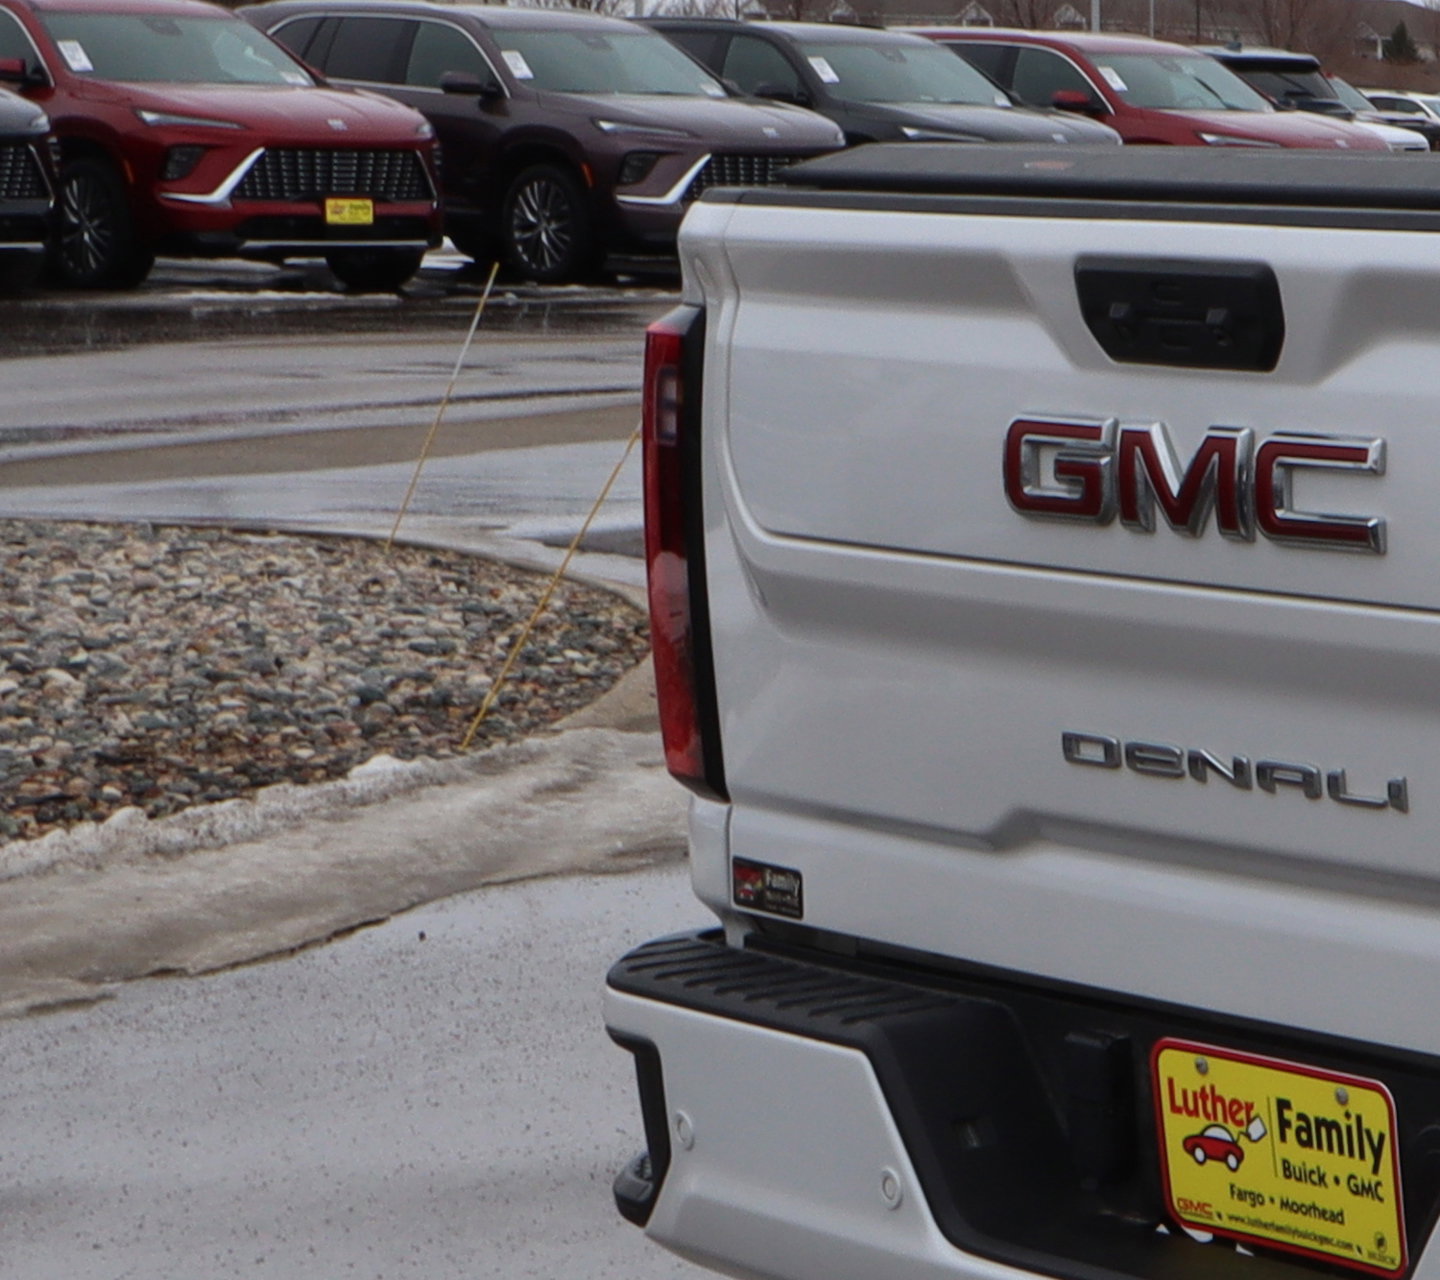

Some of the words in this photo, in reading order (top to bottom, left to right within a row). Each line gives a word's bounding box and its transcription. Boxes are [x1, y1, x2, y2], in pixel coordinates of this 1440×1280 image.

[1003, 412, 1388, 556] GMC
[1061, 731, 1409, 813] DENALI
[1168, 1077, 1254, 1127] Luther
[1276, 1097, 1385, 1175] Family
[1230, 1184, 1265, 1207] Fargo
[1280, 1196, 1345, 1225] Moorhead
[1280, 1158, 1328, 1188] Buick
[1347, 1174, 1384, 1202] GMC
